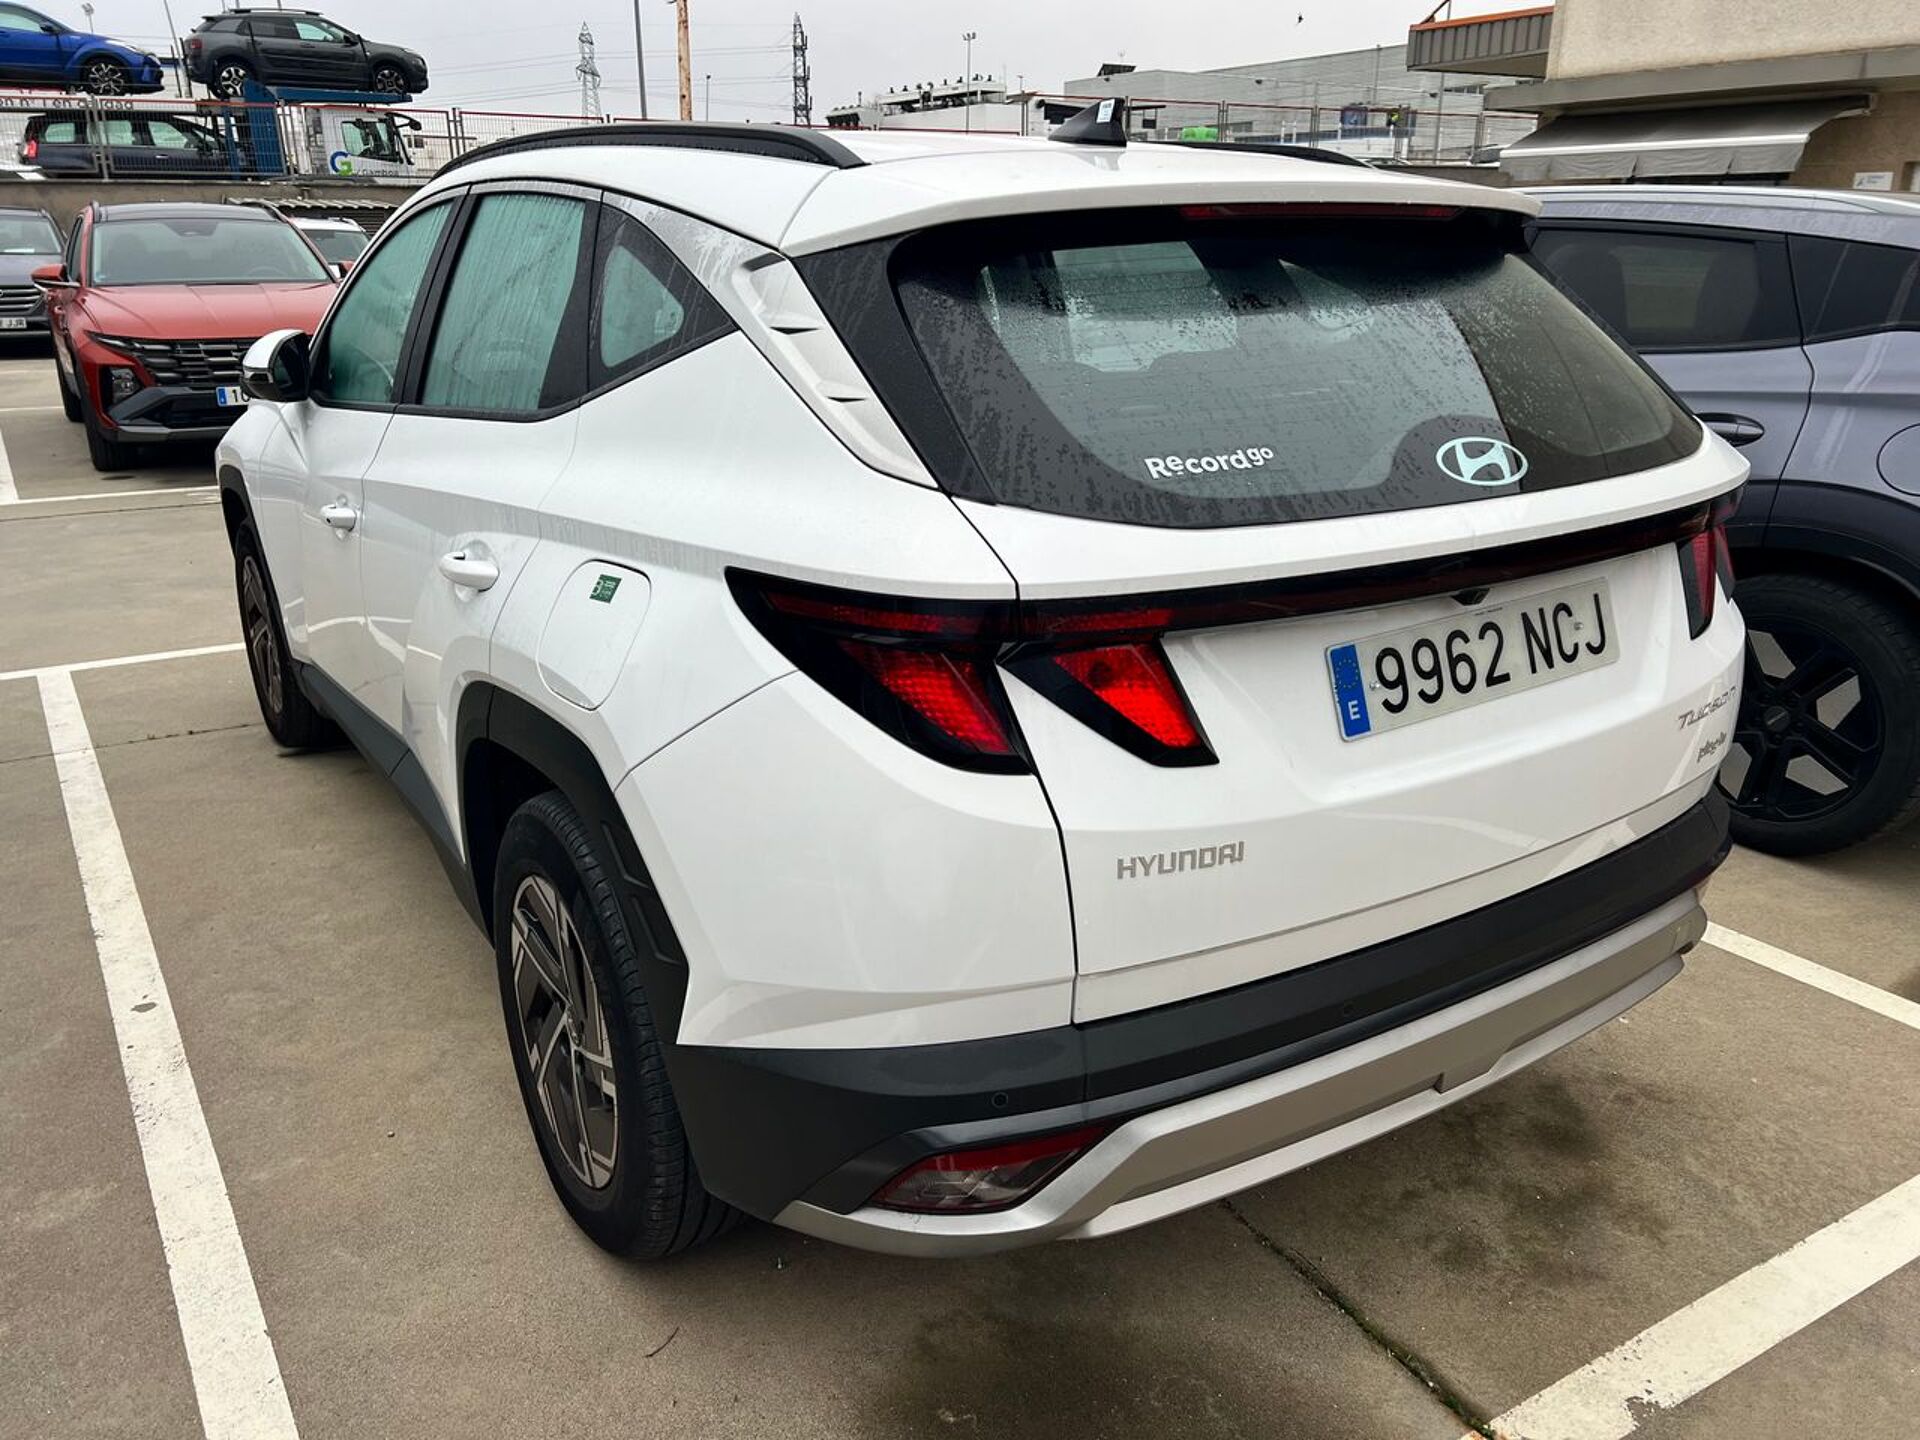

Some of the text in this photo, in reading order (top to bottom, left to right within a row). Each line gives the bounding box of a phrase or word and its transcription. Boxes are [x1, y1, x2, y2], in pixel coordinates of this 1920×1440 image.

[1348, 592, 1606, 721] E 9962 NCJ
[1117, 841, 1244, 880] HYUNDAI
